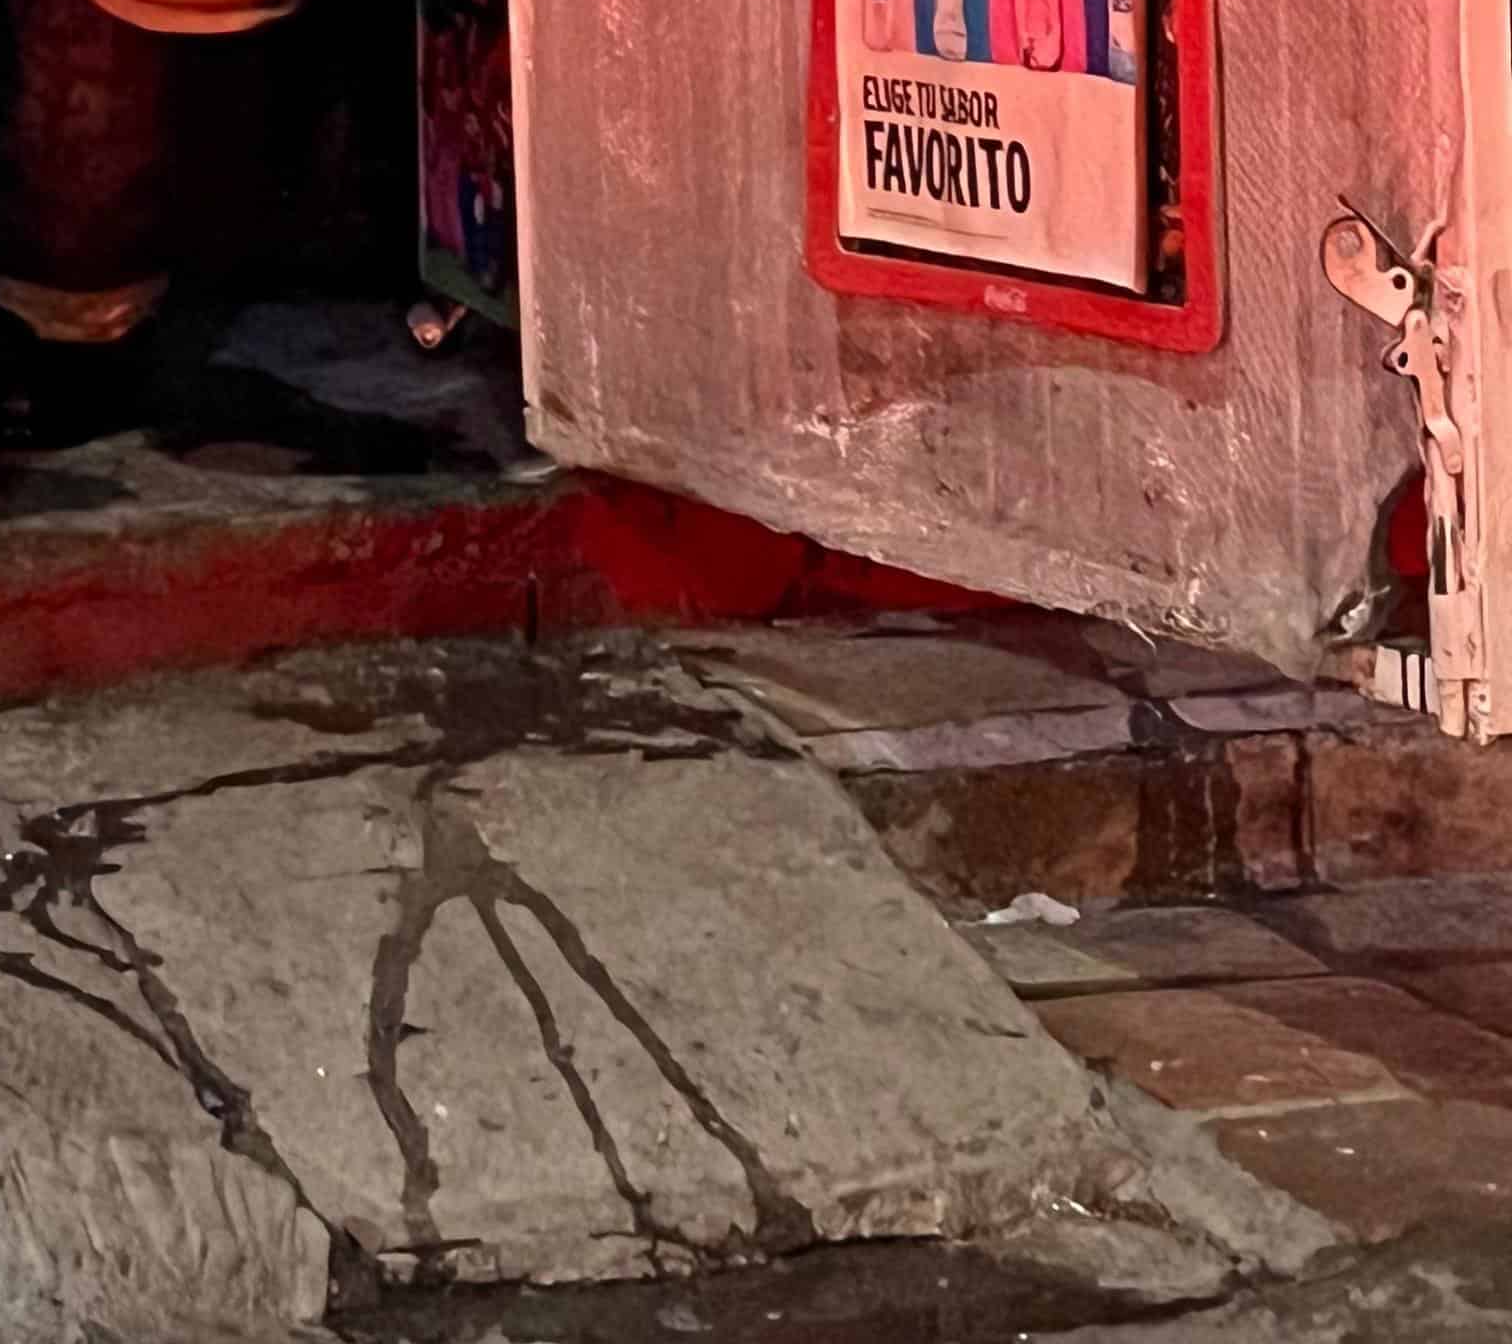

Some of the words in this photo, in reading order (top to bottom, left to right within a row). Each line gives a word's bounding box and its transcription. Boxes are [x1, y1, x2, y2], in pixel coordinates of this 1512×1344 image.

[863, 74, 915, 117] ELIGE
[915, 80, 937, 120] TU
[938, 83, 1001, 131] SABOR
[863, 119, 1032, 214] FAVORITO
